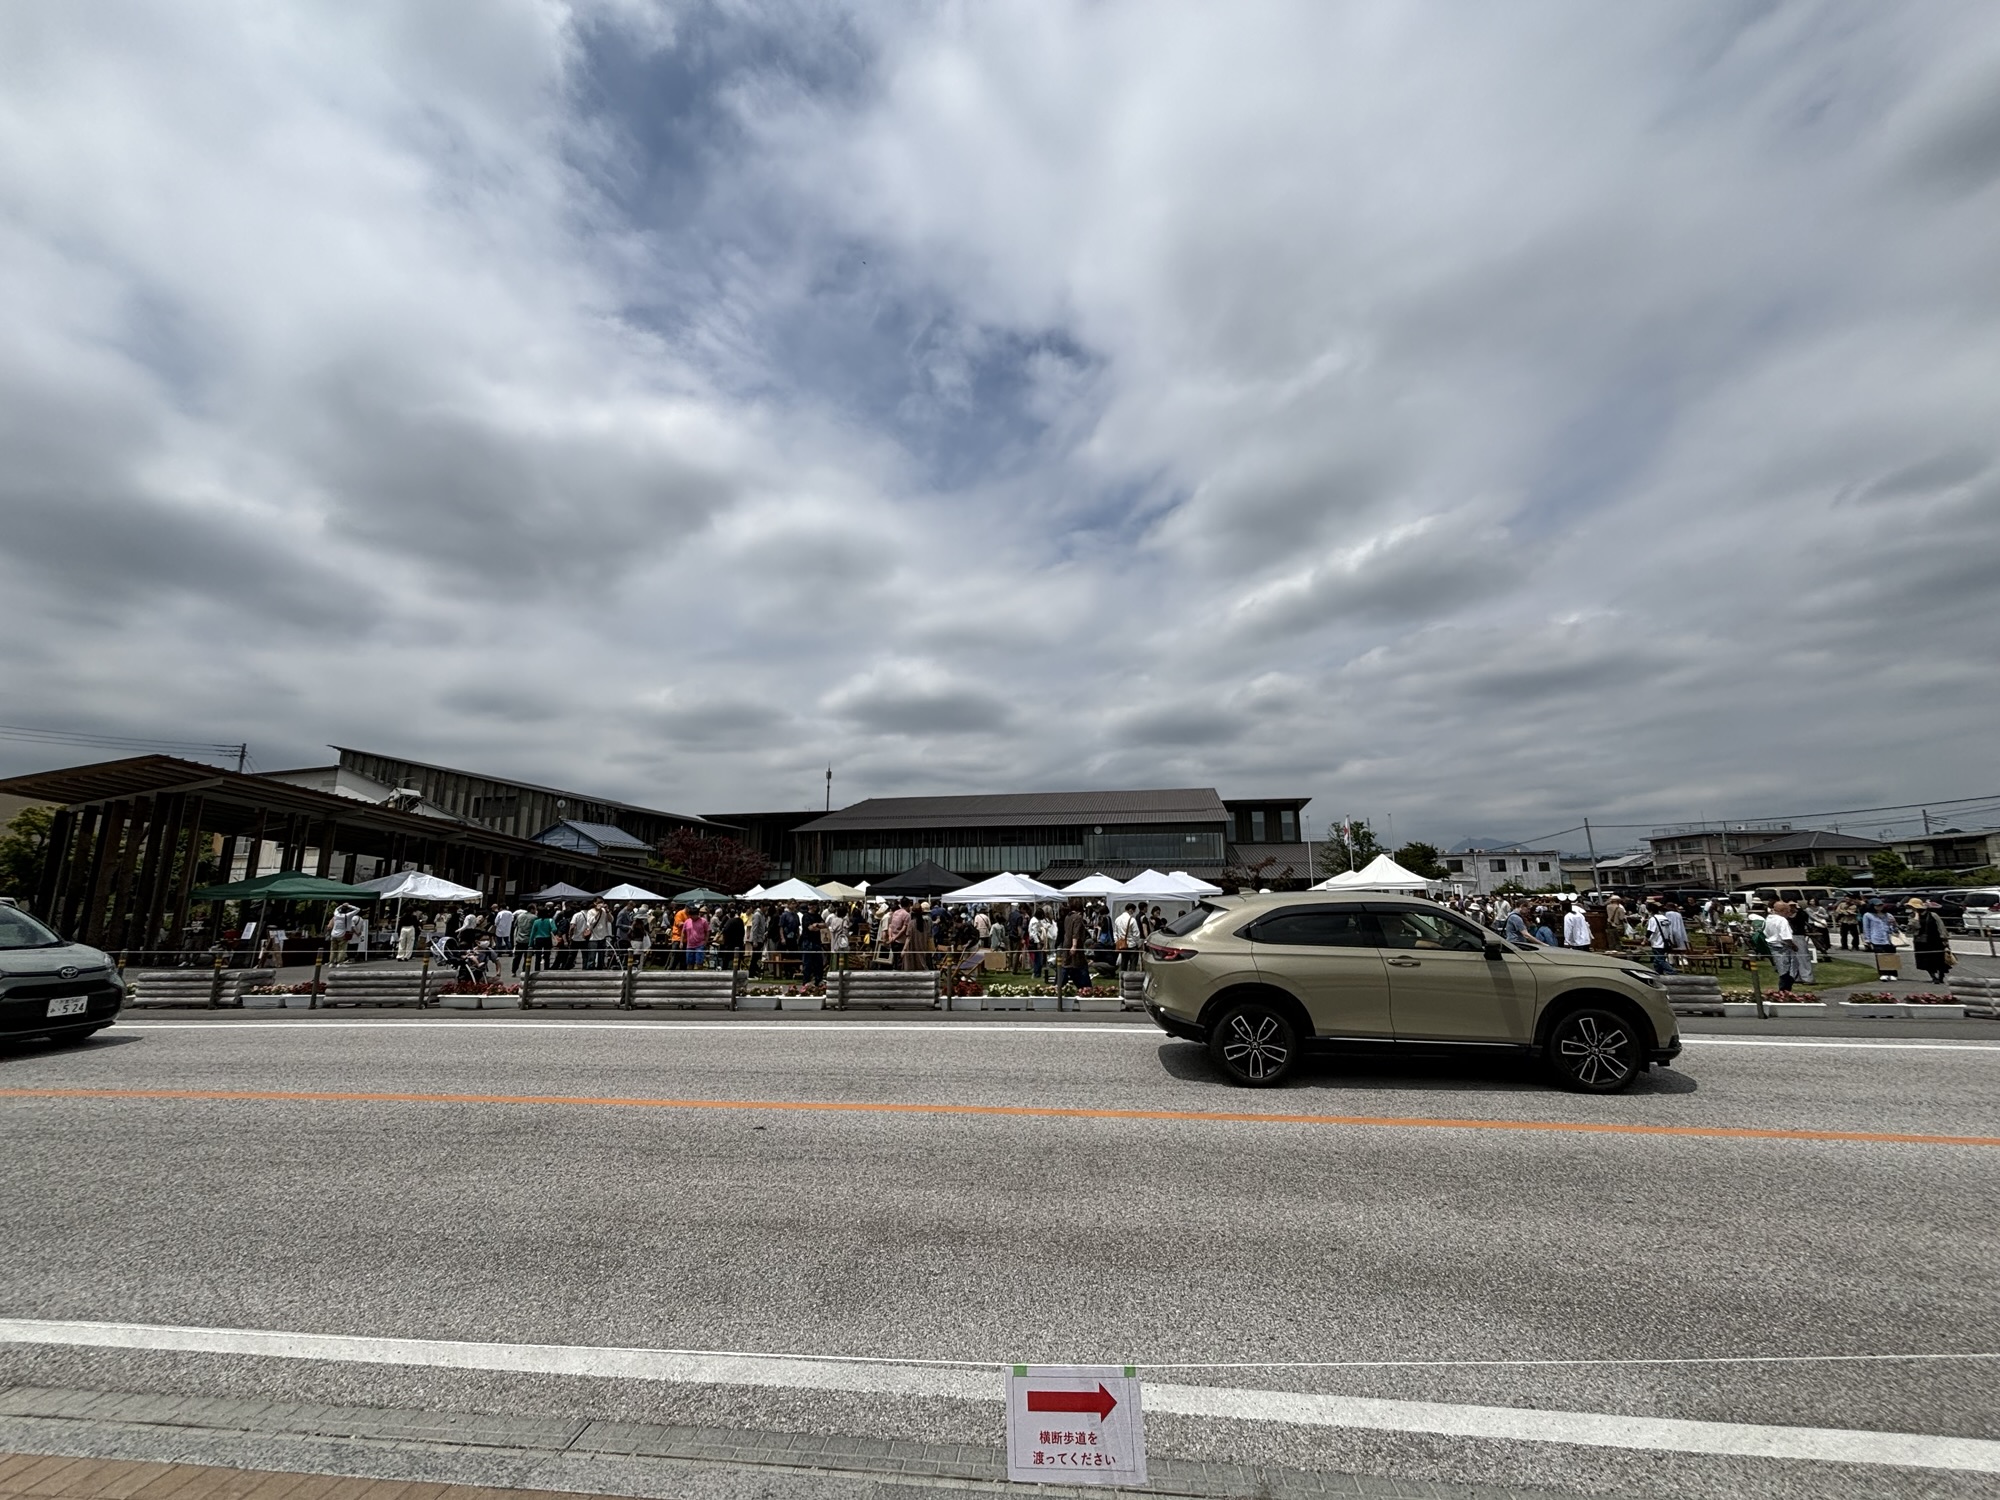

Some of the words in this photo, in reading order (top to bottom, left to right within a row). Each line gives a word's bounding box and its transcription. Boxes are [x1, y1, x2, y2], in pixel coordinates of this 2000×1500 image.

[1039, 1430, 1098, 1445] 横断歩道を
[1033, 1451, 1116, 1465] 渡ってください
